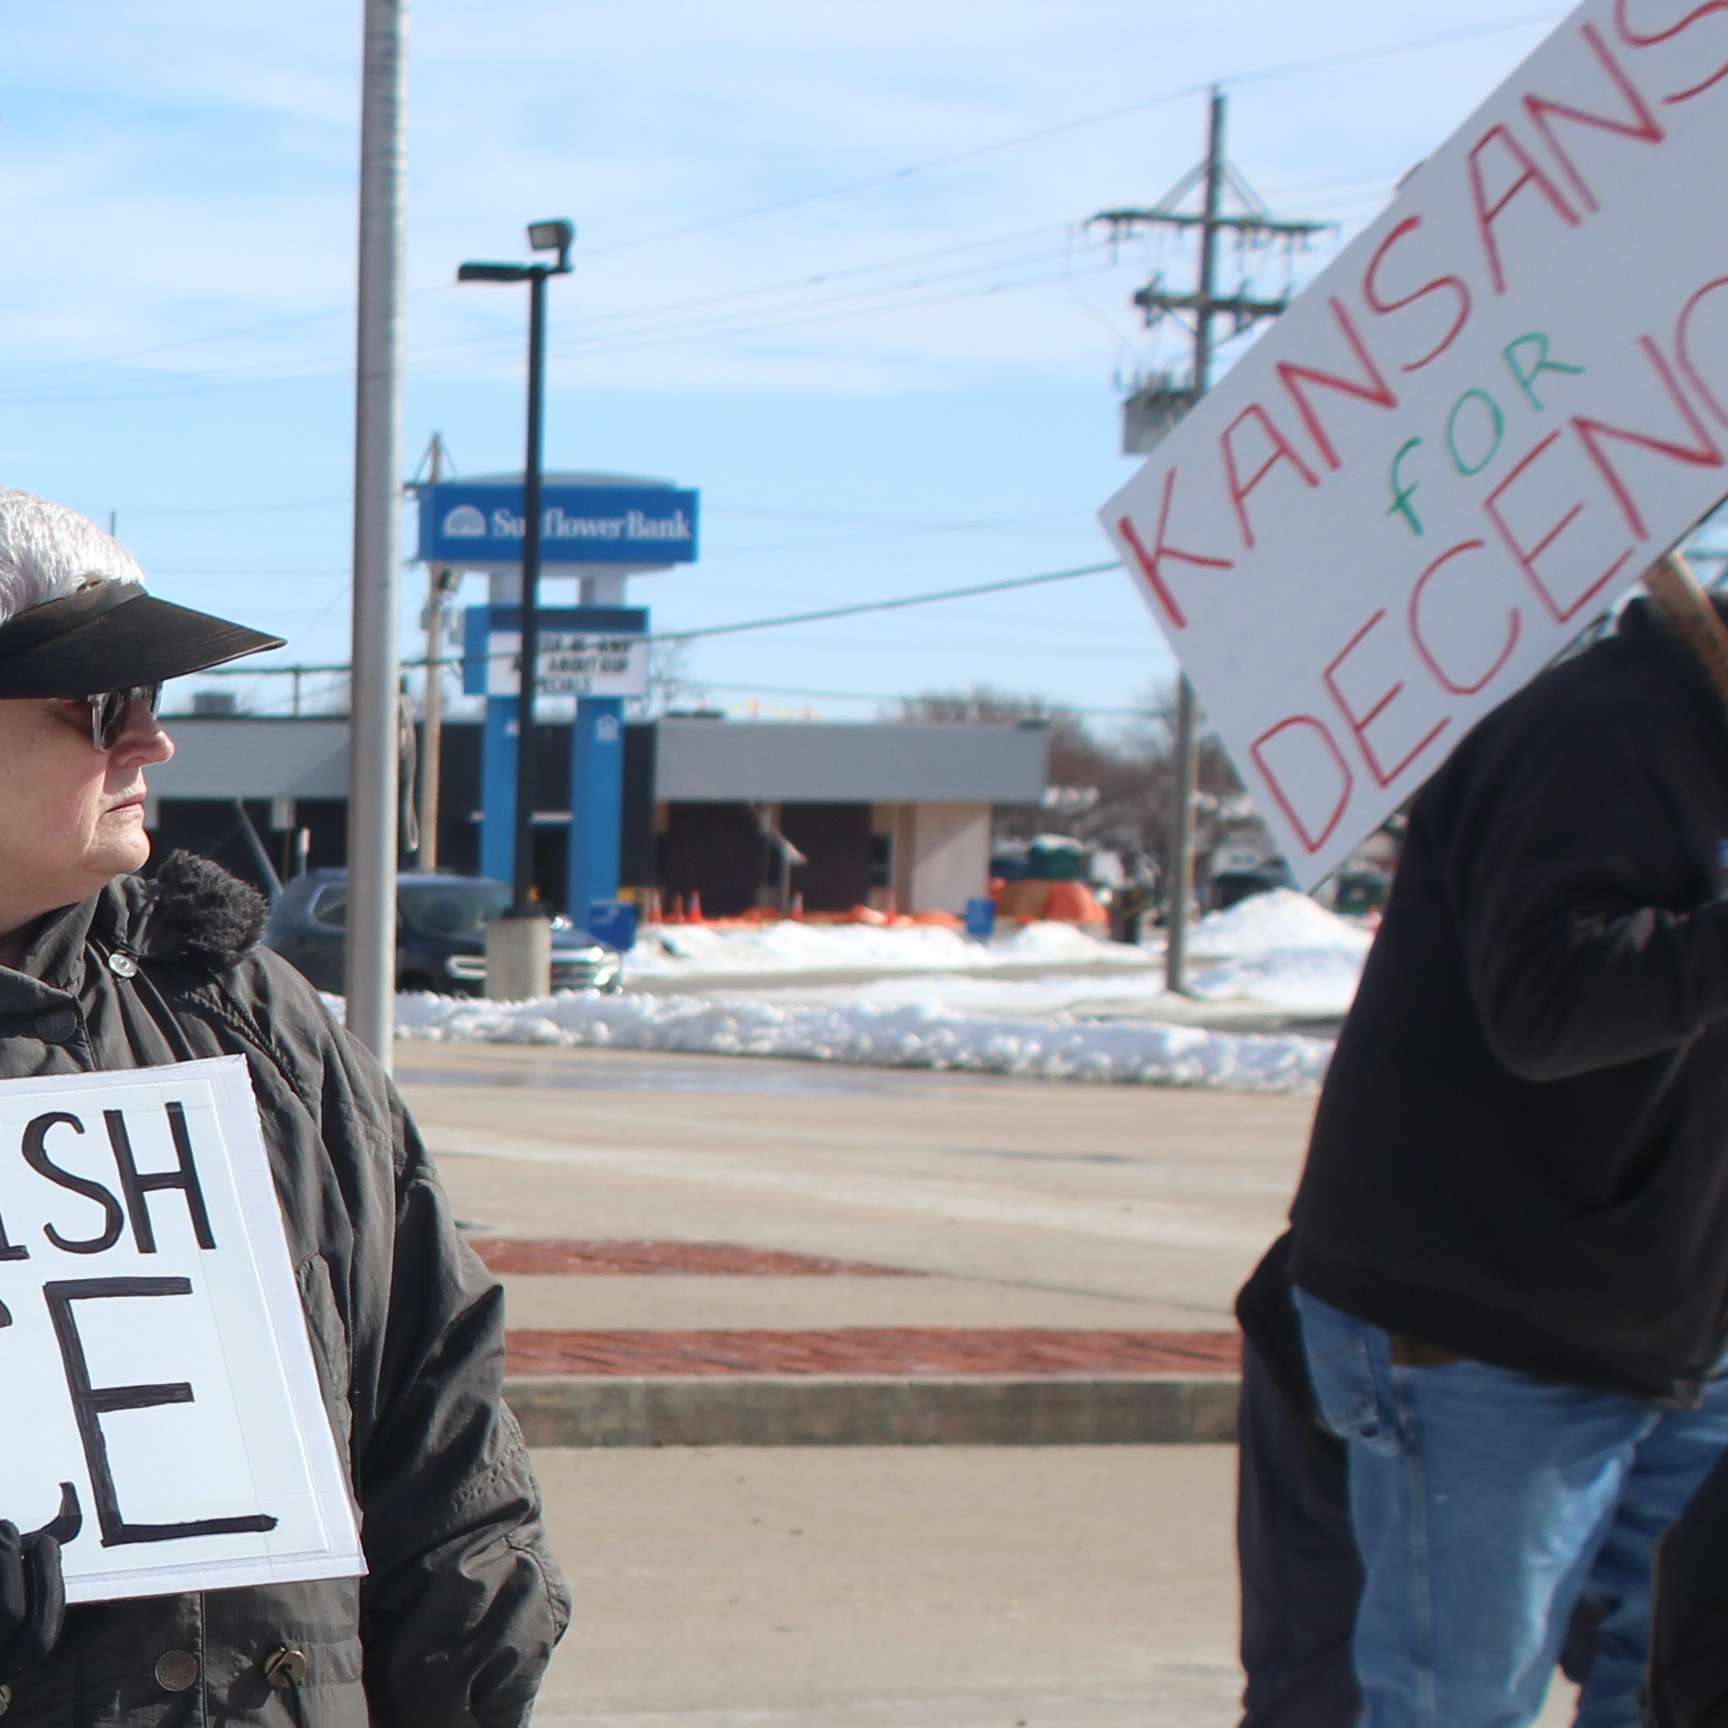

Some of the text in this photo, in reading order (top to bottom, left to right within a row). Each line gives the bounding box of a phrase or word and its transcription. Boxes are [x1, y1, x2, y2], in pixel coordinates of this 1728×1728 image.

[1117, 0, 1728, 630] KANSANS
[493, 507, 691, 540] Suflower Bank
